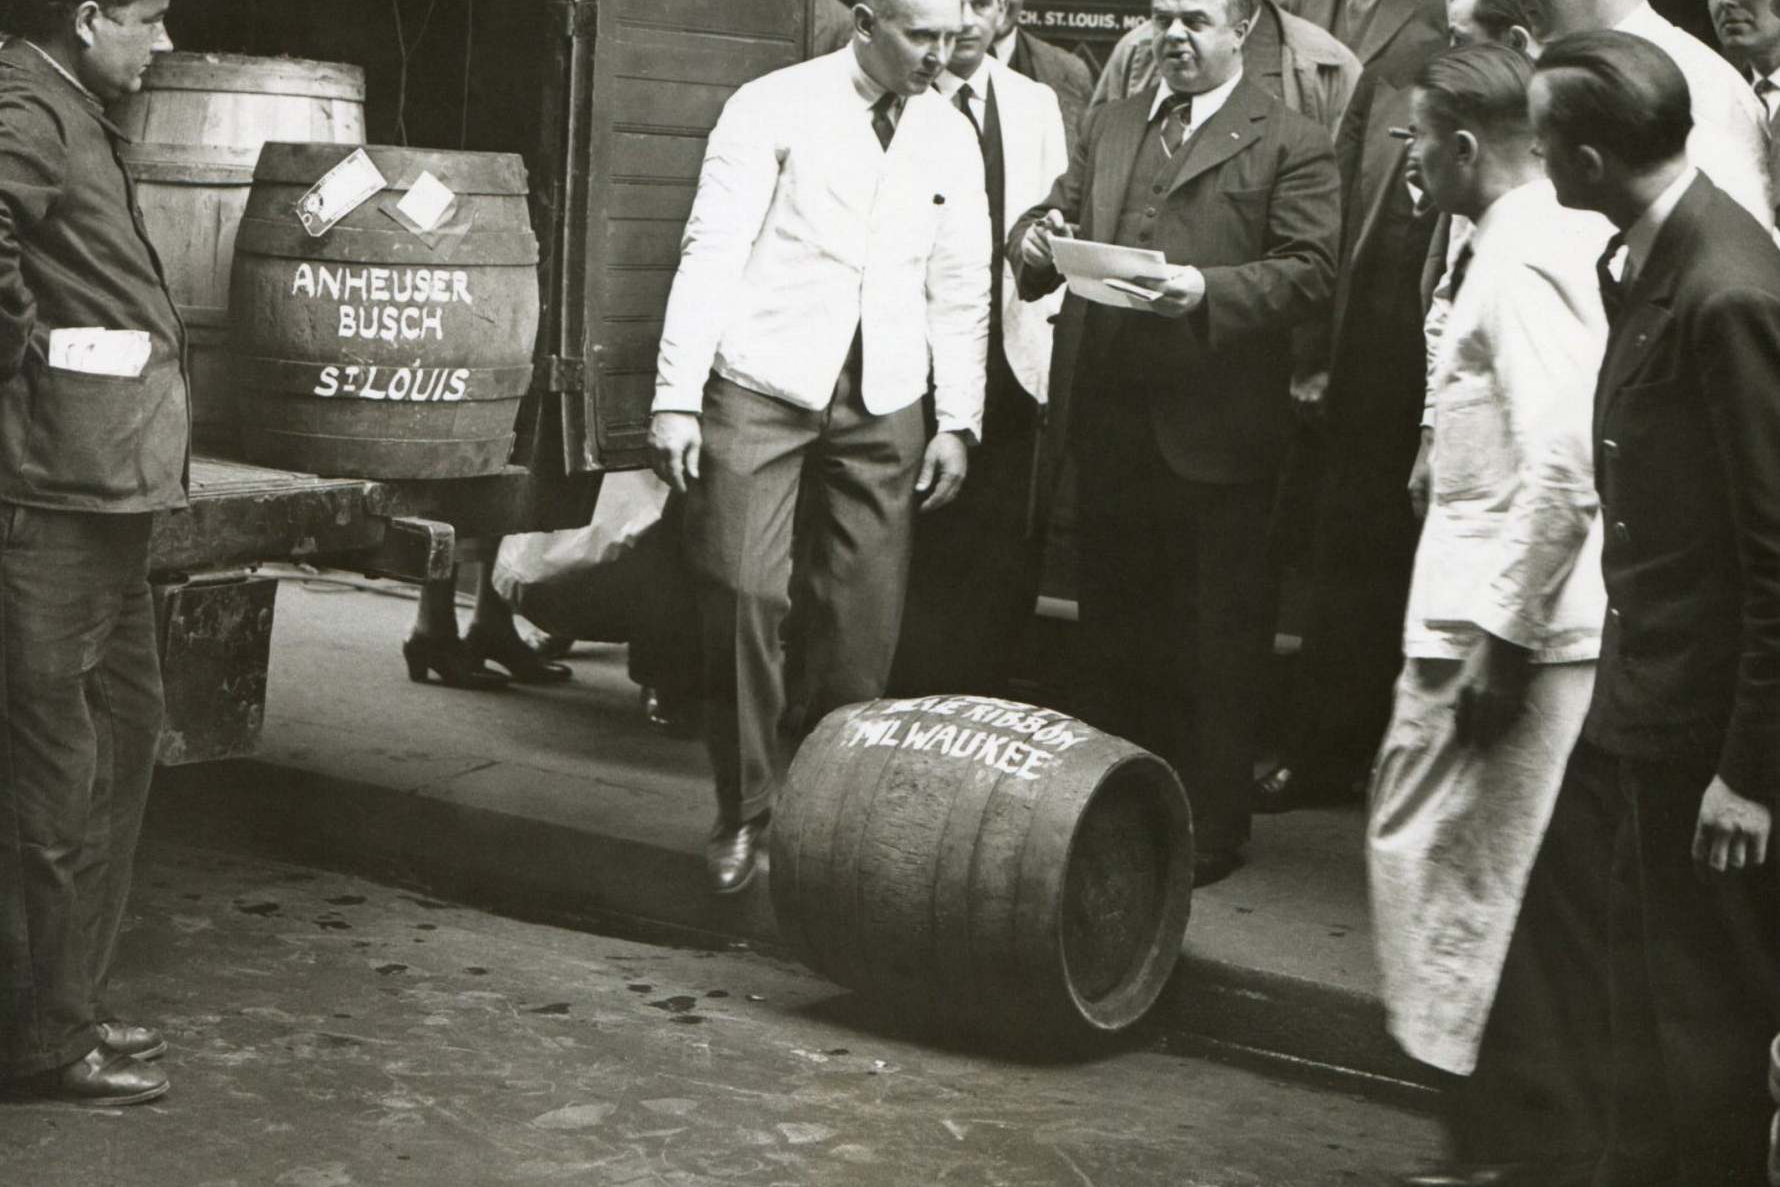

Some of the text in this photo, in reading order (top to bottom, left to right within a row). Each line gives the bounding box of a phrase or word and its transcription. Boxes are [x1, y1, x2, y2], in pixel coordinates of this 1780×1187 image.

[292, 262, 472, 304] ANHEUSER
[338, 305, 443, 341] BUSCH
[359, 366, 470, 401] LOUIS
